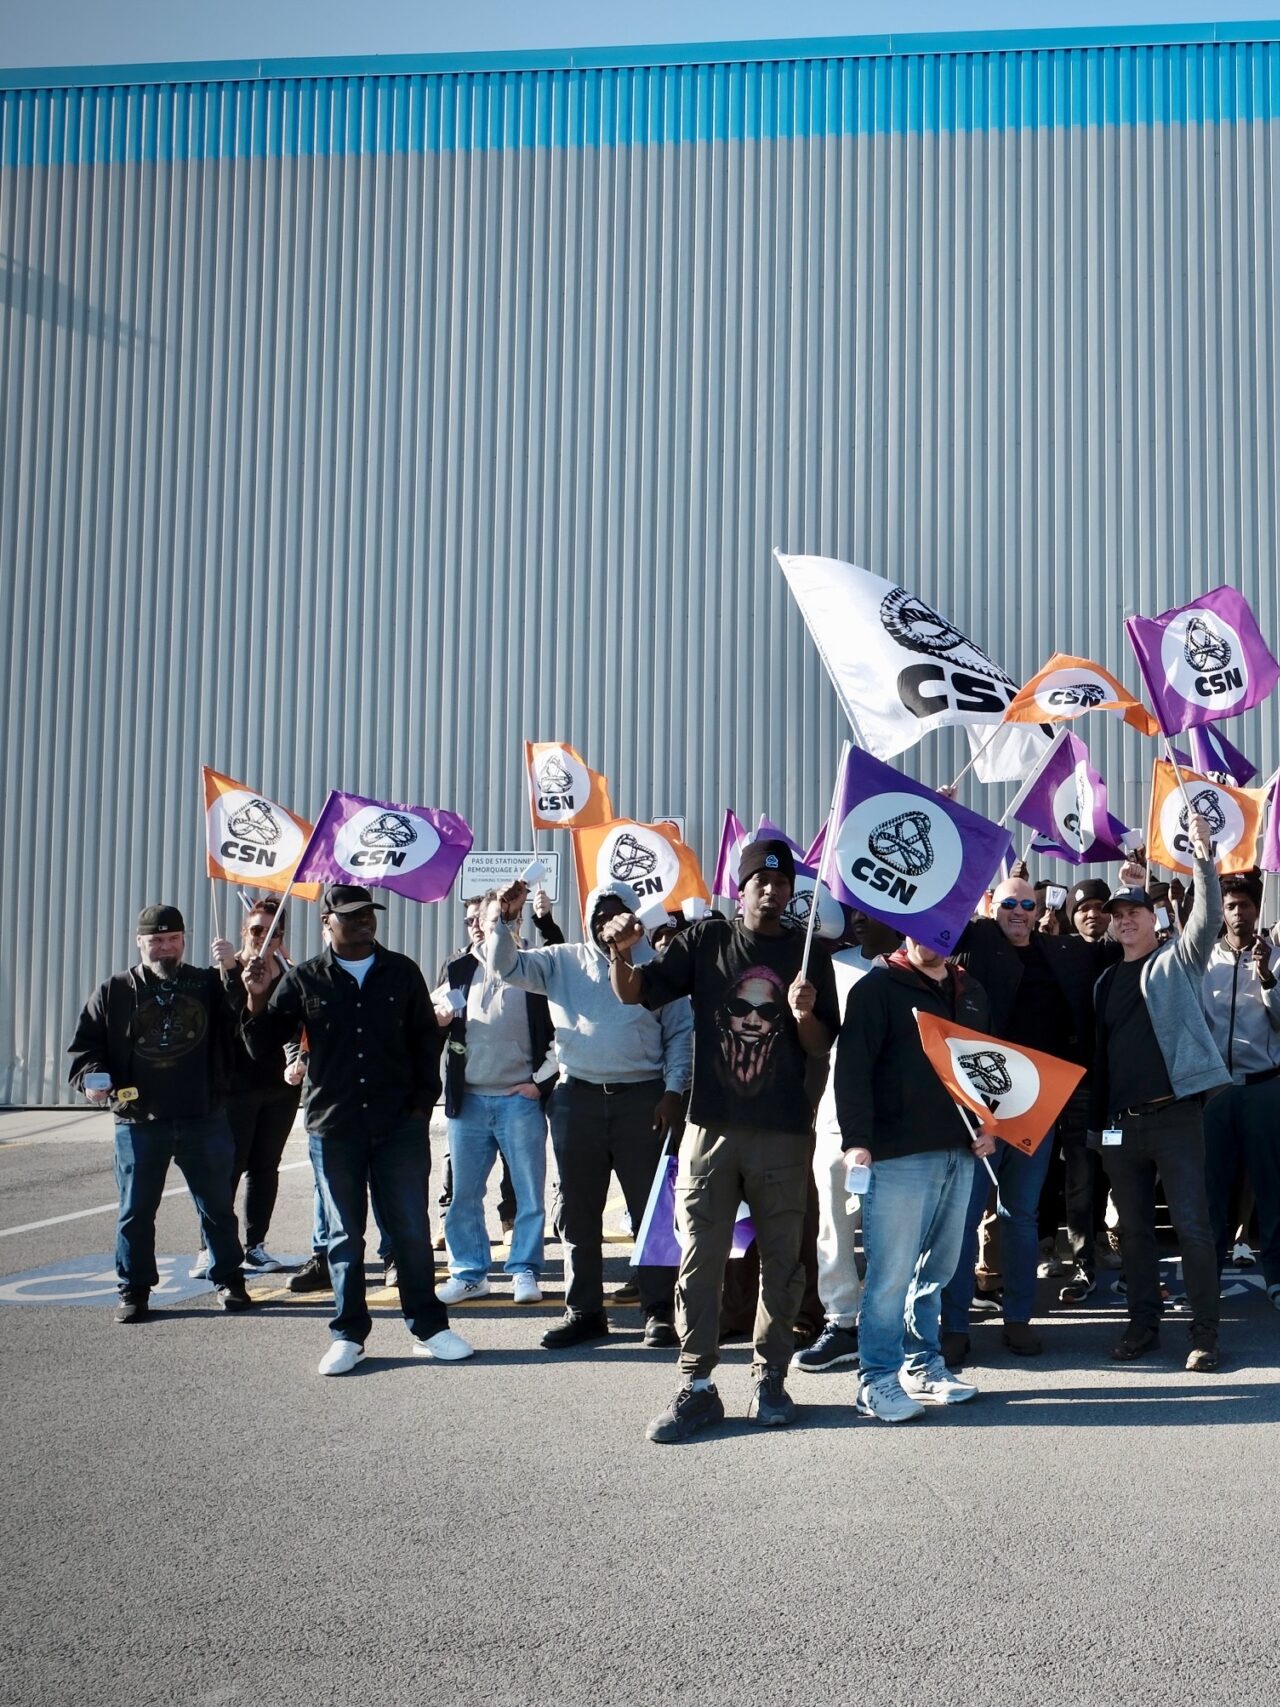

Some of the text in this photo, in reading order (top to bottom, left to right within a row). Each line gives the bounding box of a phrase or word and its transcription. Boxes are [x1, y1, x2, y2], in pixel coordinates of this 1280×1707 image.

[897, 664, 1020, 718] CS
[1195, 667, 1243, 697] CSN
[1048, 688, 1101, 708] CSN
[538, 795, 574, 811] CSN
[220, 841, 277, 868] CSN
[350, 850, 407, 868] CSN
[467, 866, 512, 874] REMORQUAGE
[632, 876, 663, 898] SN
[851, 857, 918, 906] CSN
